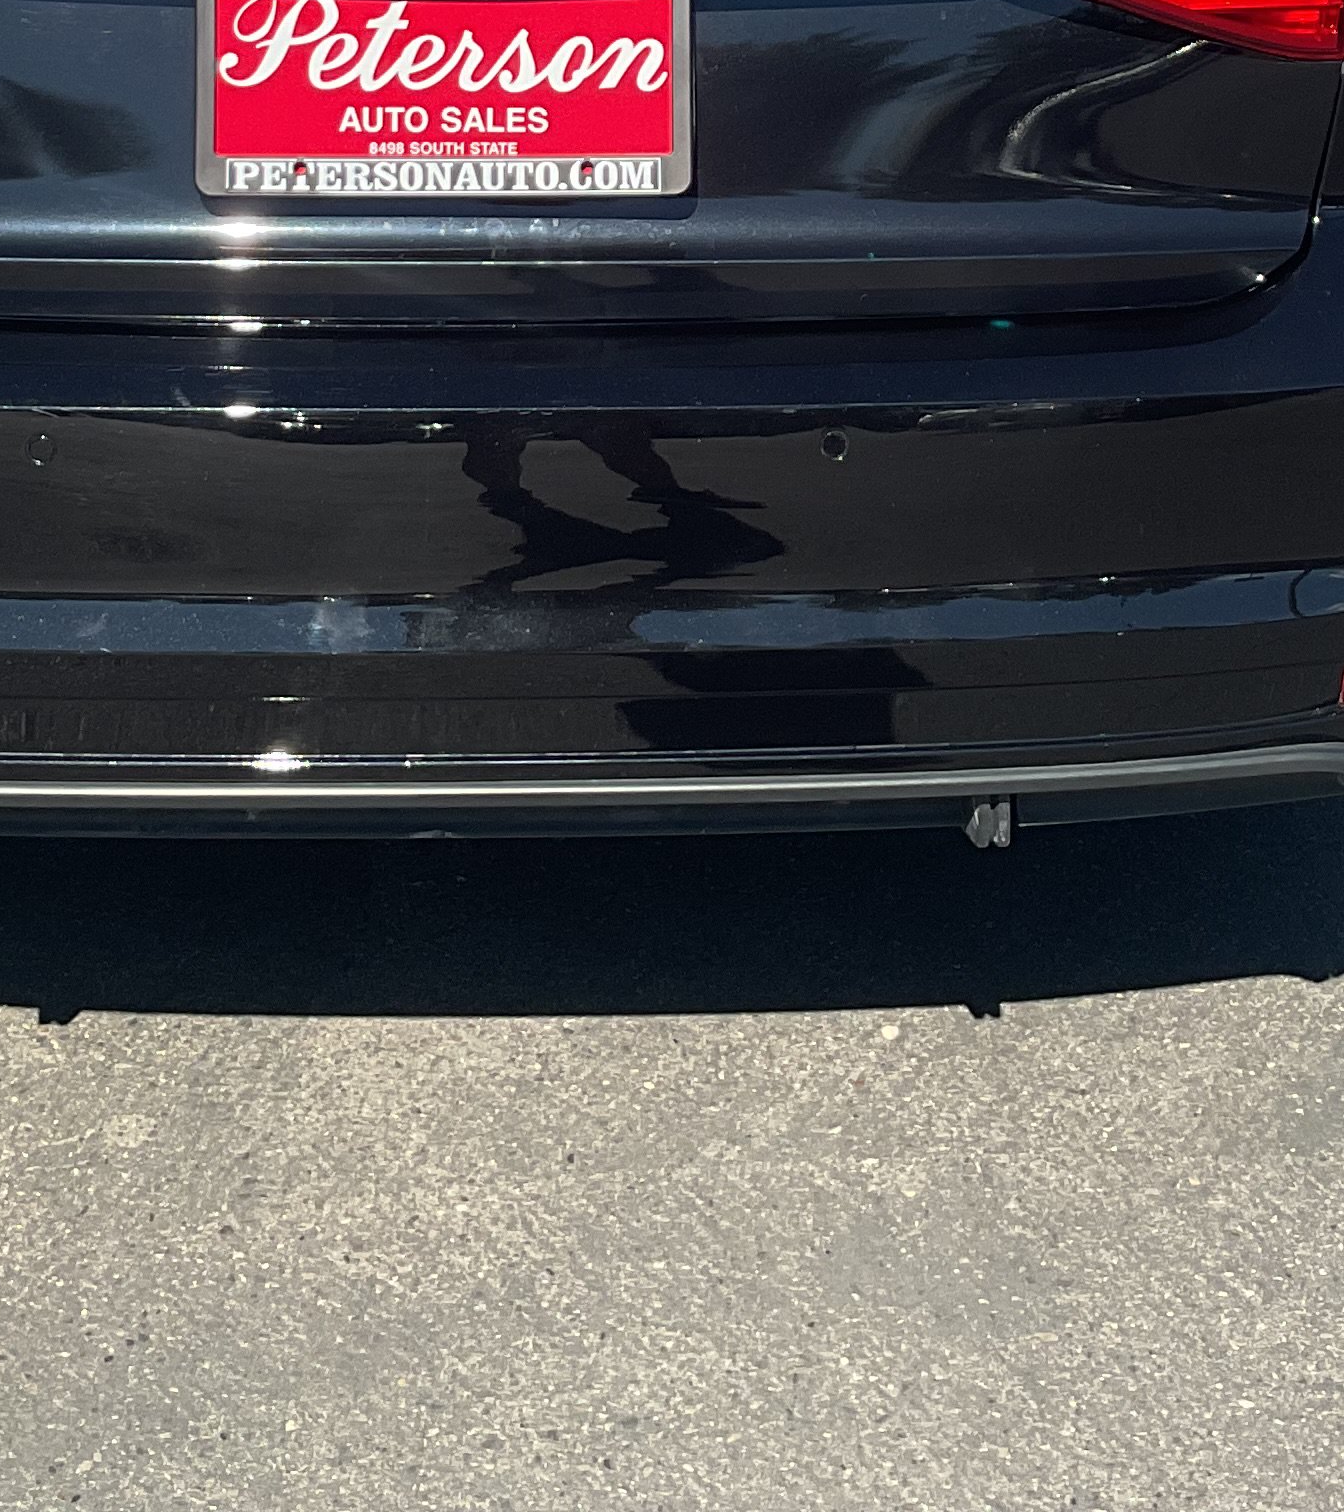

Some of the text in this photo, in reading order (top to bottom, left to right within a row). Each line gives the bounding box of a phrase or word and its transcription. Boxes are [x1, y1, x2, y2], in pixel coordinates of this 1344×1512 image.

[339, 106, 549, 134] AUTO SALES
[369, 141, 518, 156] 8498 SOUTH STATE
[233, 161, 654, 191] PETERSONAUTO.COM
